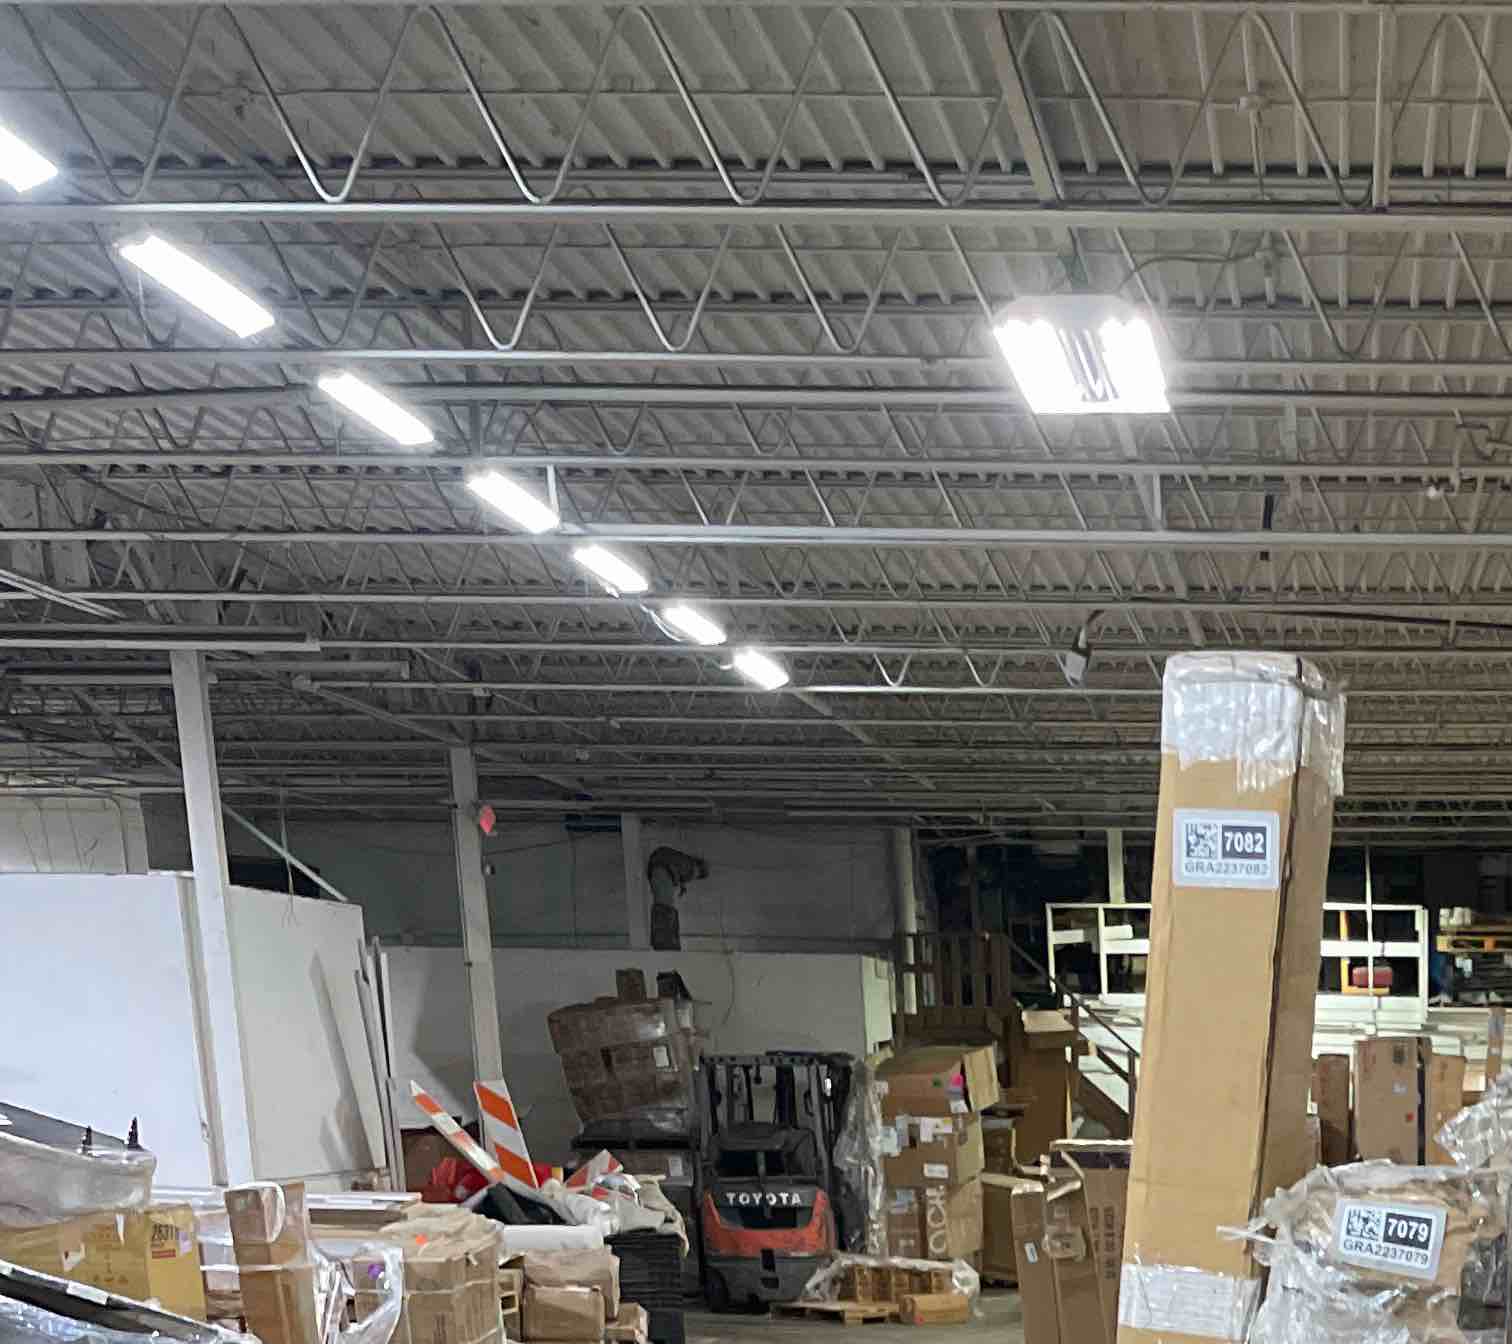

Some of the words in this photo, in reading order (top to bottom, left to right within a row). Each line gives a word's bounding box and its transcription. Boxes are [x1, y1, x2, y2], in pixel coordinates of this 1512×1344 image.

[1223, 832, 1266, 854] 7082
[1184, 861, 1269, 876] GRA2237082
[726, 1191, 802, 1207] TOYOTA
[1387, 1218, 1429, 1243] 7079
[1343, 1239, 1430, 1266] GRA2237079
